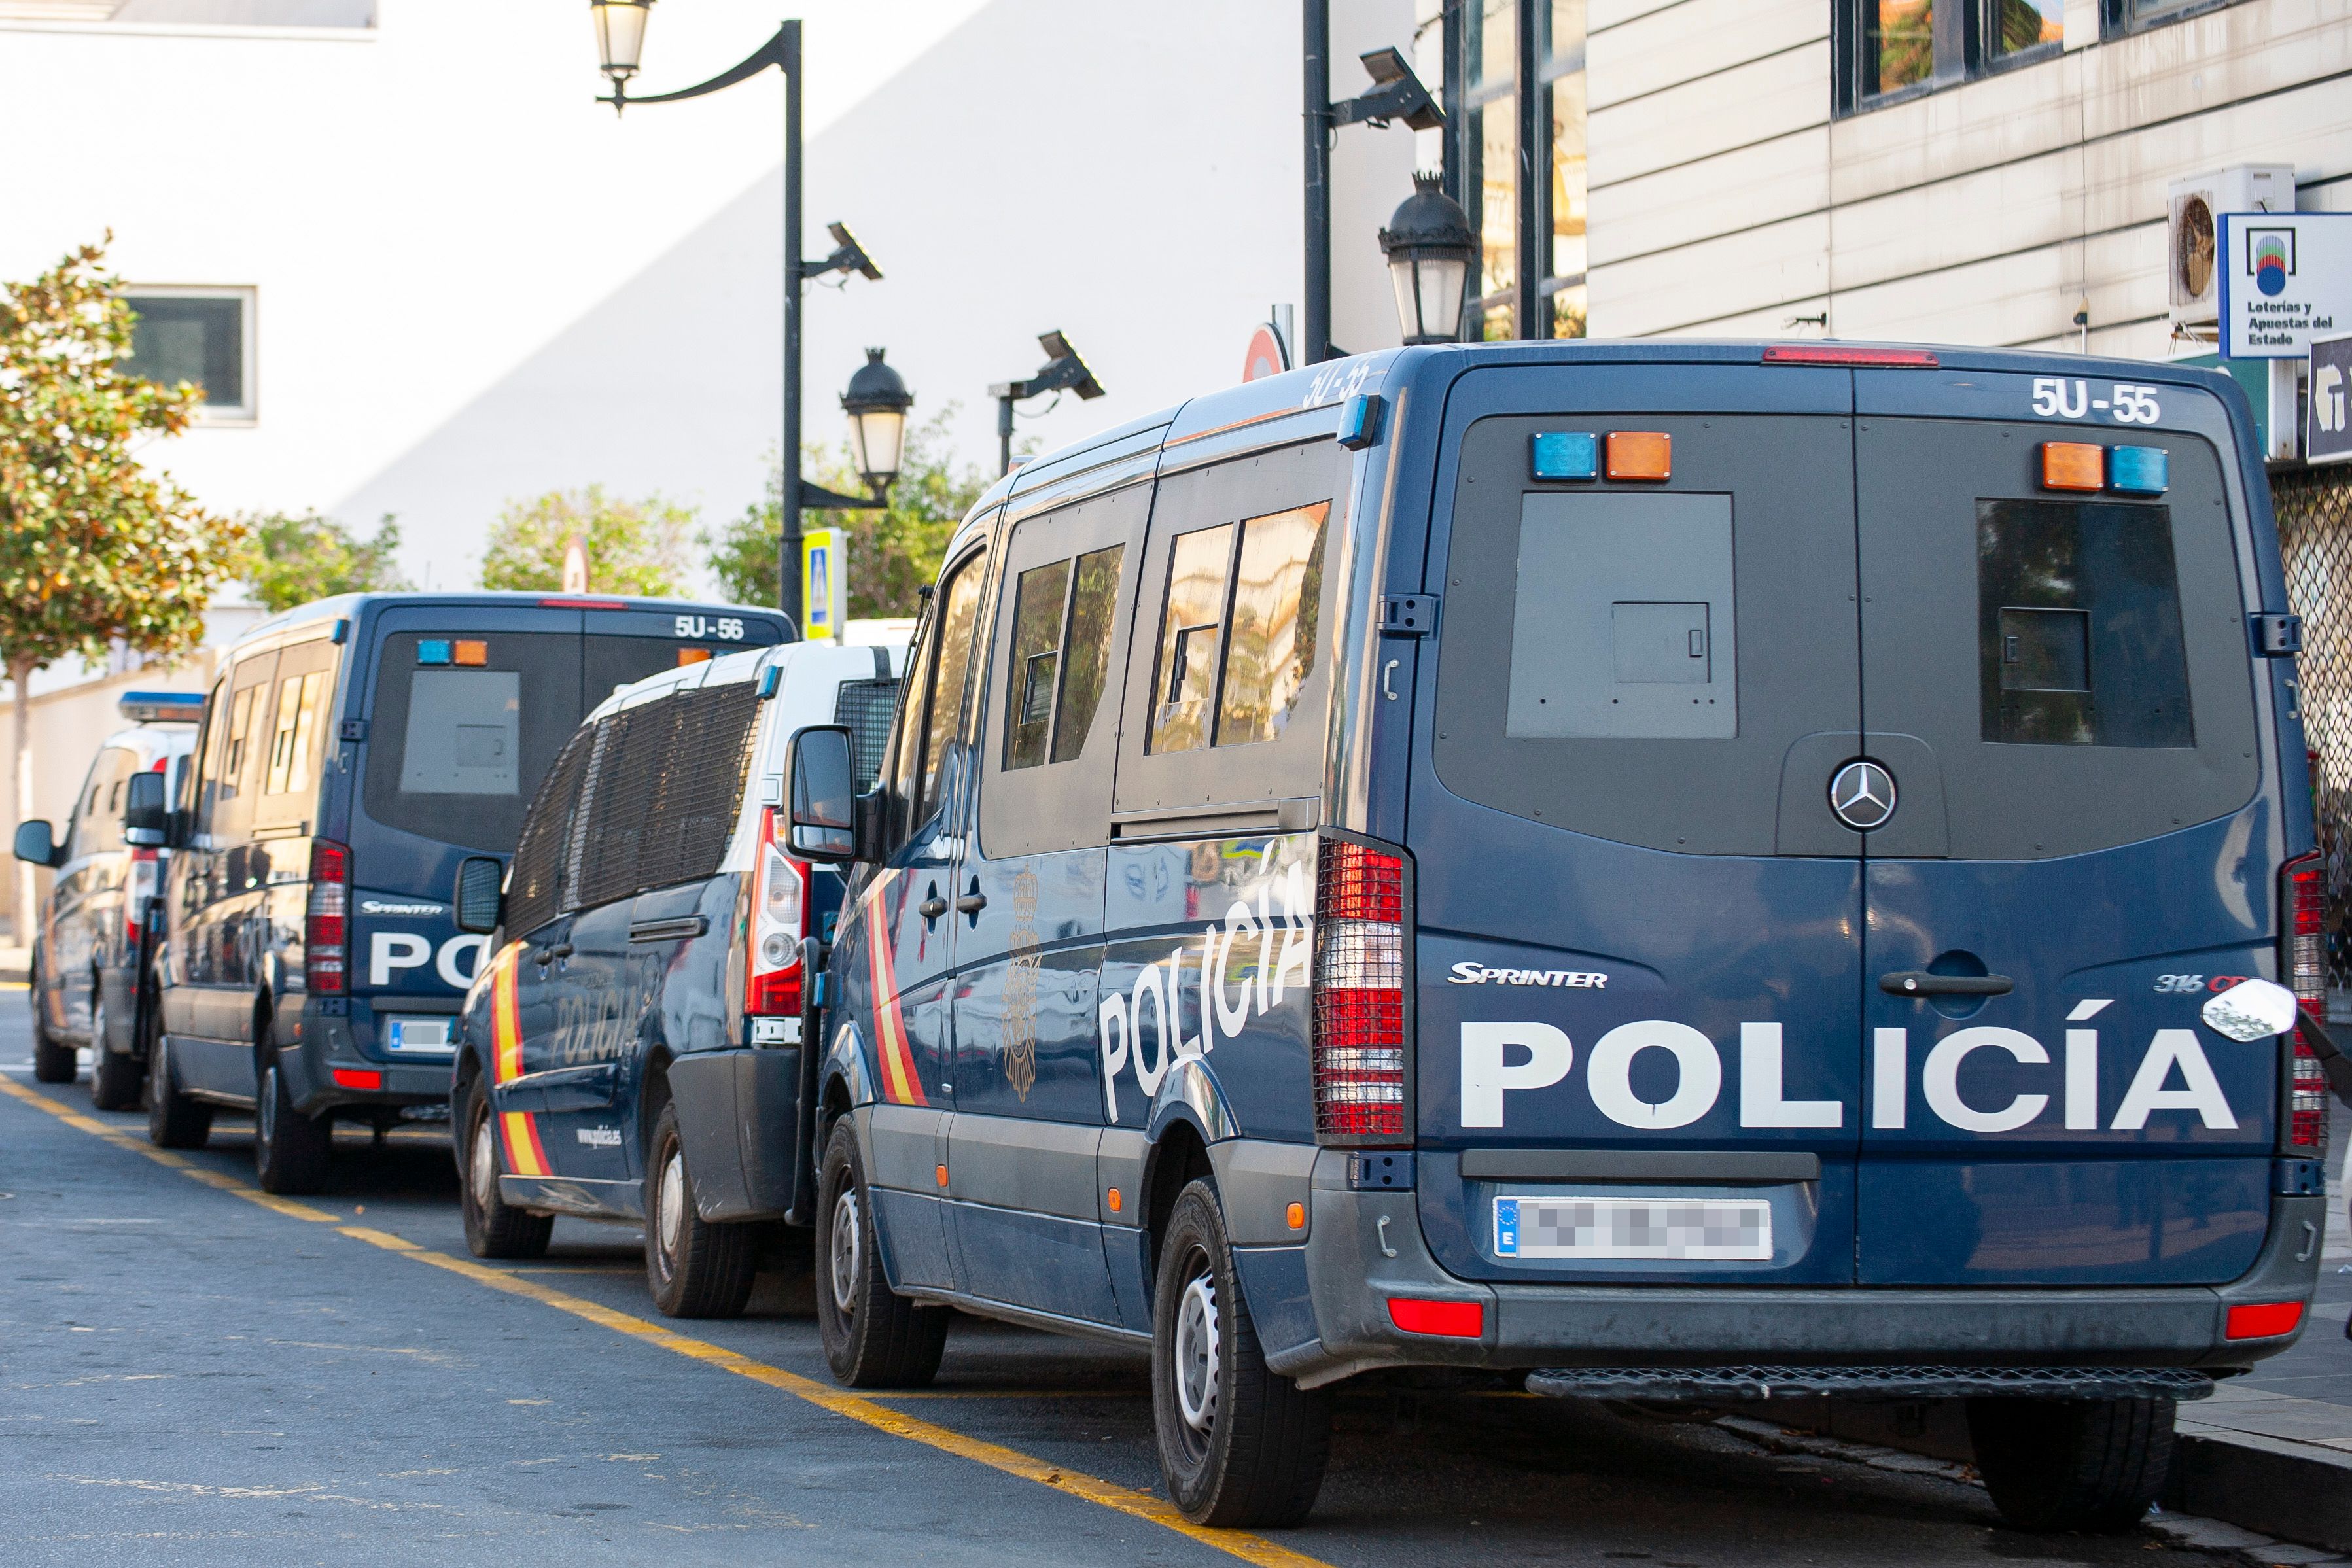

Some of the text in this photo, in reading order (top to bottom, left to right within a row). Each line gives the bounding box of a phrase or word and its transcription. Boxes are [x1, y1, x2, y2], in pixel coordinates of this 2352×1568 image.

[2247, 300, 2311, 315] Loterías y
[2249, 316, 2332, 332] Apuestas del
[2248, 332, 2293, 345] Estado
[2032, 377, 2160, 425] 5U-55
[675, 616, 744, 640] 5U-56
[1100, 839, 1314, 1124] POLICÍA
[2153, 974, 2205, 993] 316
[1460, 999, 2239, 1132] POLICÍA
[1503, 1232, 1514, 1245] E
